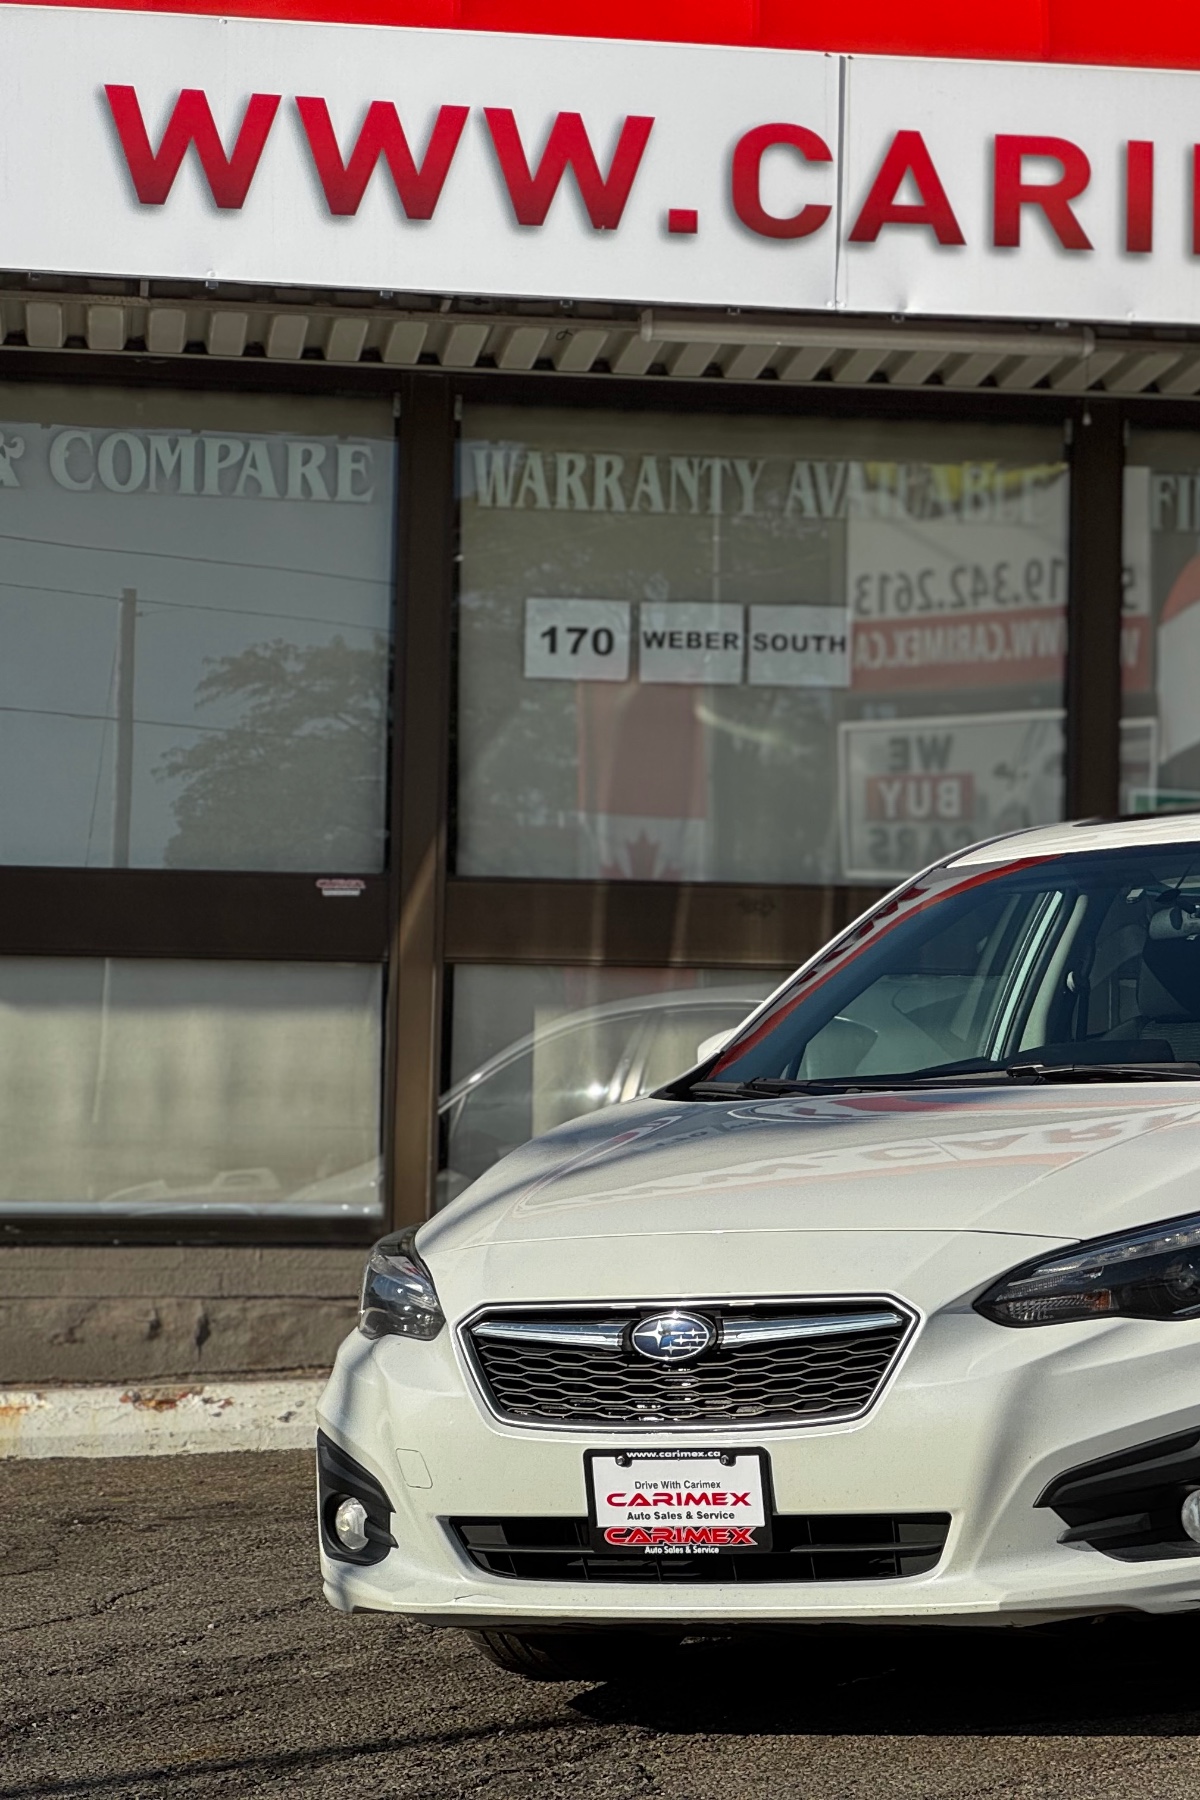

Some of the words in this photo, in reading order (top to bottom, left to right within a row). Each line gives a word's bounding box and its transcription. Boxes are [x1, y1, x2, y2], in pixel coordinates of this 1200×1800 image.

[49, 430, 374, 503] COMPARE
[474, 449, 765, 517] WARRANTY
[540, 626, 615, 656] 170
[643, 630, 739, 651] WEBER
[753, 631, 847, 654] SOUTH
[626, 1449, 721, 1458] www.carimex.ca
[634, 1480, 659, 1490] Drive
[660, 1480, 681, 1490] With
[684, 1480, 721, 1489] Carimex
[606, 1492, 752, 1507] CARIMEX
[627, 1511, 651, 1521] Auto
[653, 1511, 682, 1521] Sales
[686, 1511, 694, 1520] &
[696, 1510, 735, 1520] Service
[604, 1526, 757, 1546] CARIMEX
[644, 1546, 662, 1555] Auto
[663, 1546, 684, 1555] Sales
[685, 1546, 692, 1554] &
[692, 1546, 720, 1554] Service
